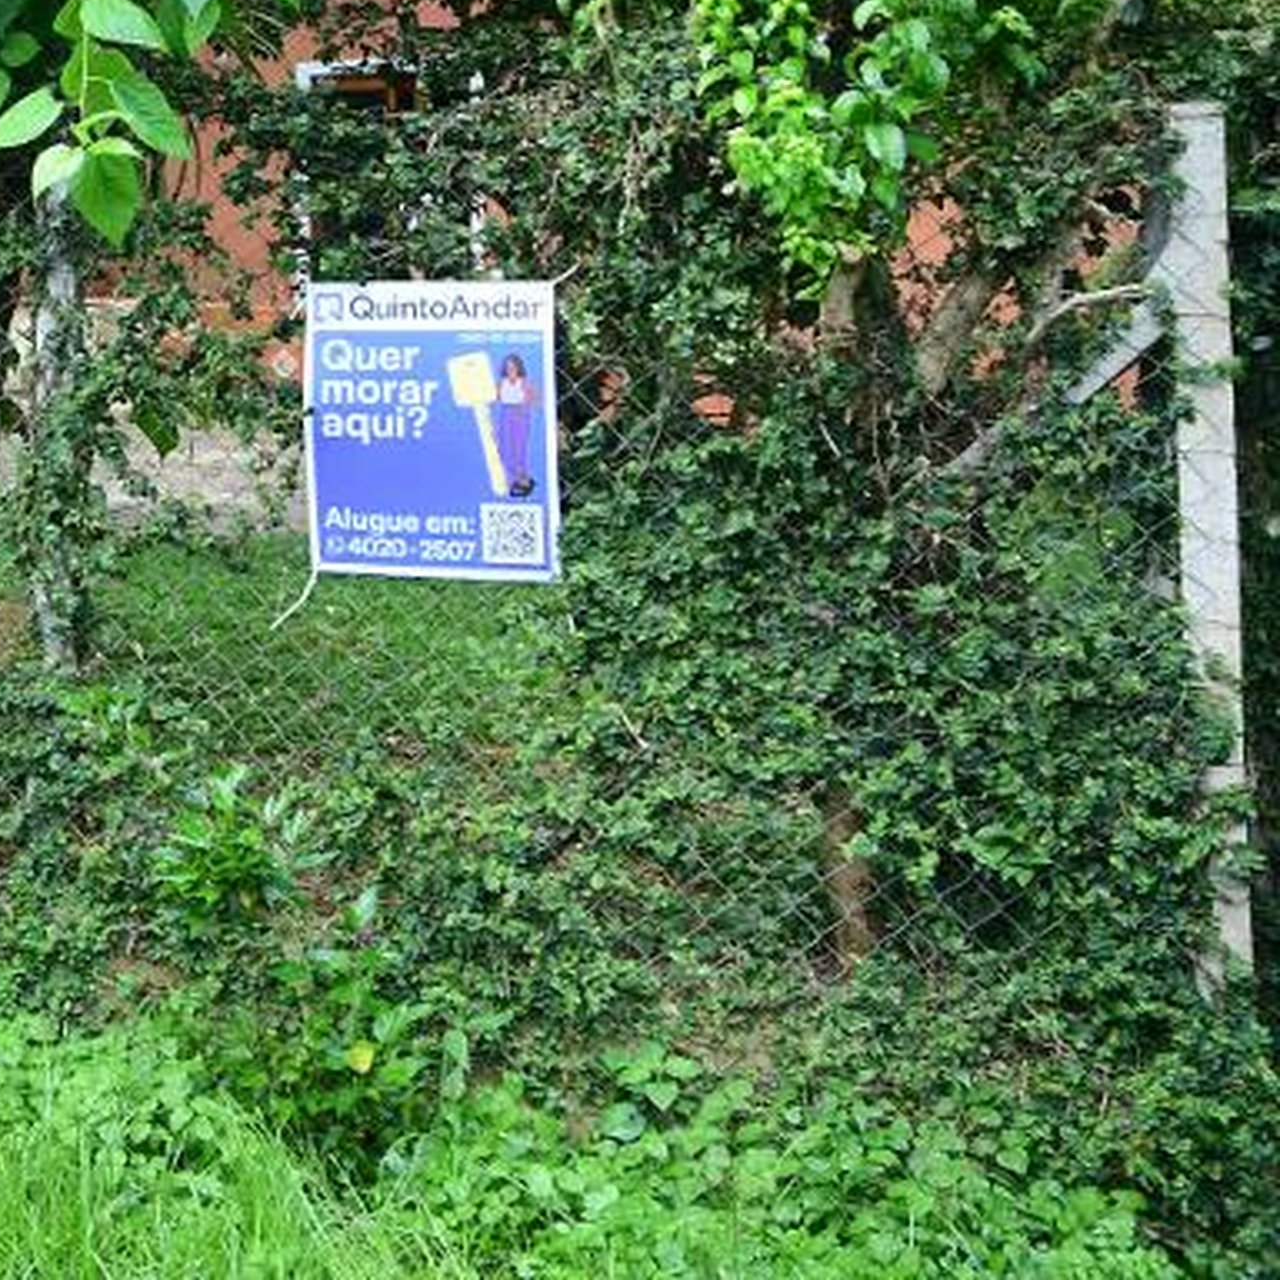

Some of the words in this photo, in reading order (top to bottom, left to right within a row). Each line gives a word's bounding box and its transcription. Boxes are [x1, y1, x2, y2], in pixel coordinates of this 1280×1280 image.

[349, 294, 543, 321] QuintoAndar
[321, 339, 420, 372] Quer
[321, 379, 439, 404] morar
[321, 408, 429, 444] aqui?
[325, 506, 419, 535] Alugue
[425, 515, 475, 535] em:
